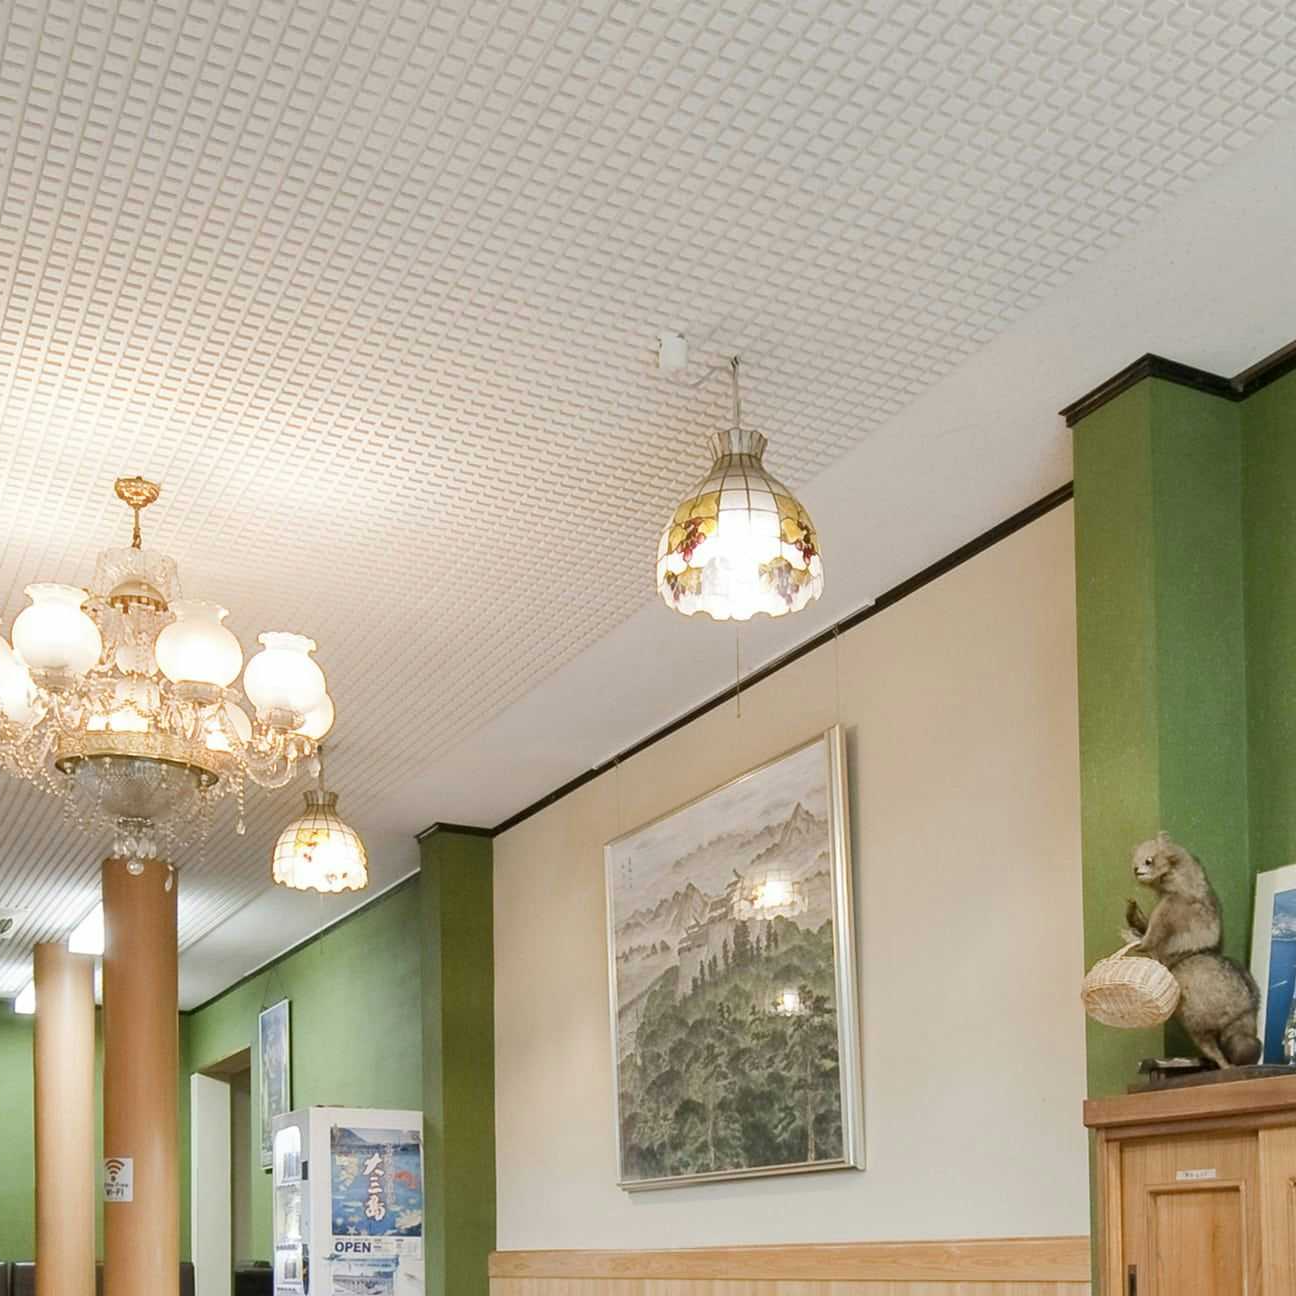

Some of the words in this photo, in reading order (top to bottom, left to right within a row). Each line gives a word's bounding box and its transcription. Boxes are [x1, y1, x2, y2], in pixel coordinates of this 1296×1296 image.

[363, 1152, 386, 1221] 大三島
[334, 1241, 372, 1254] OPEN
